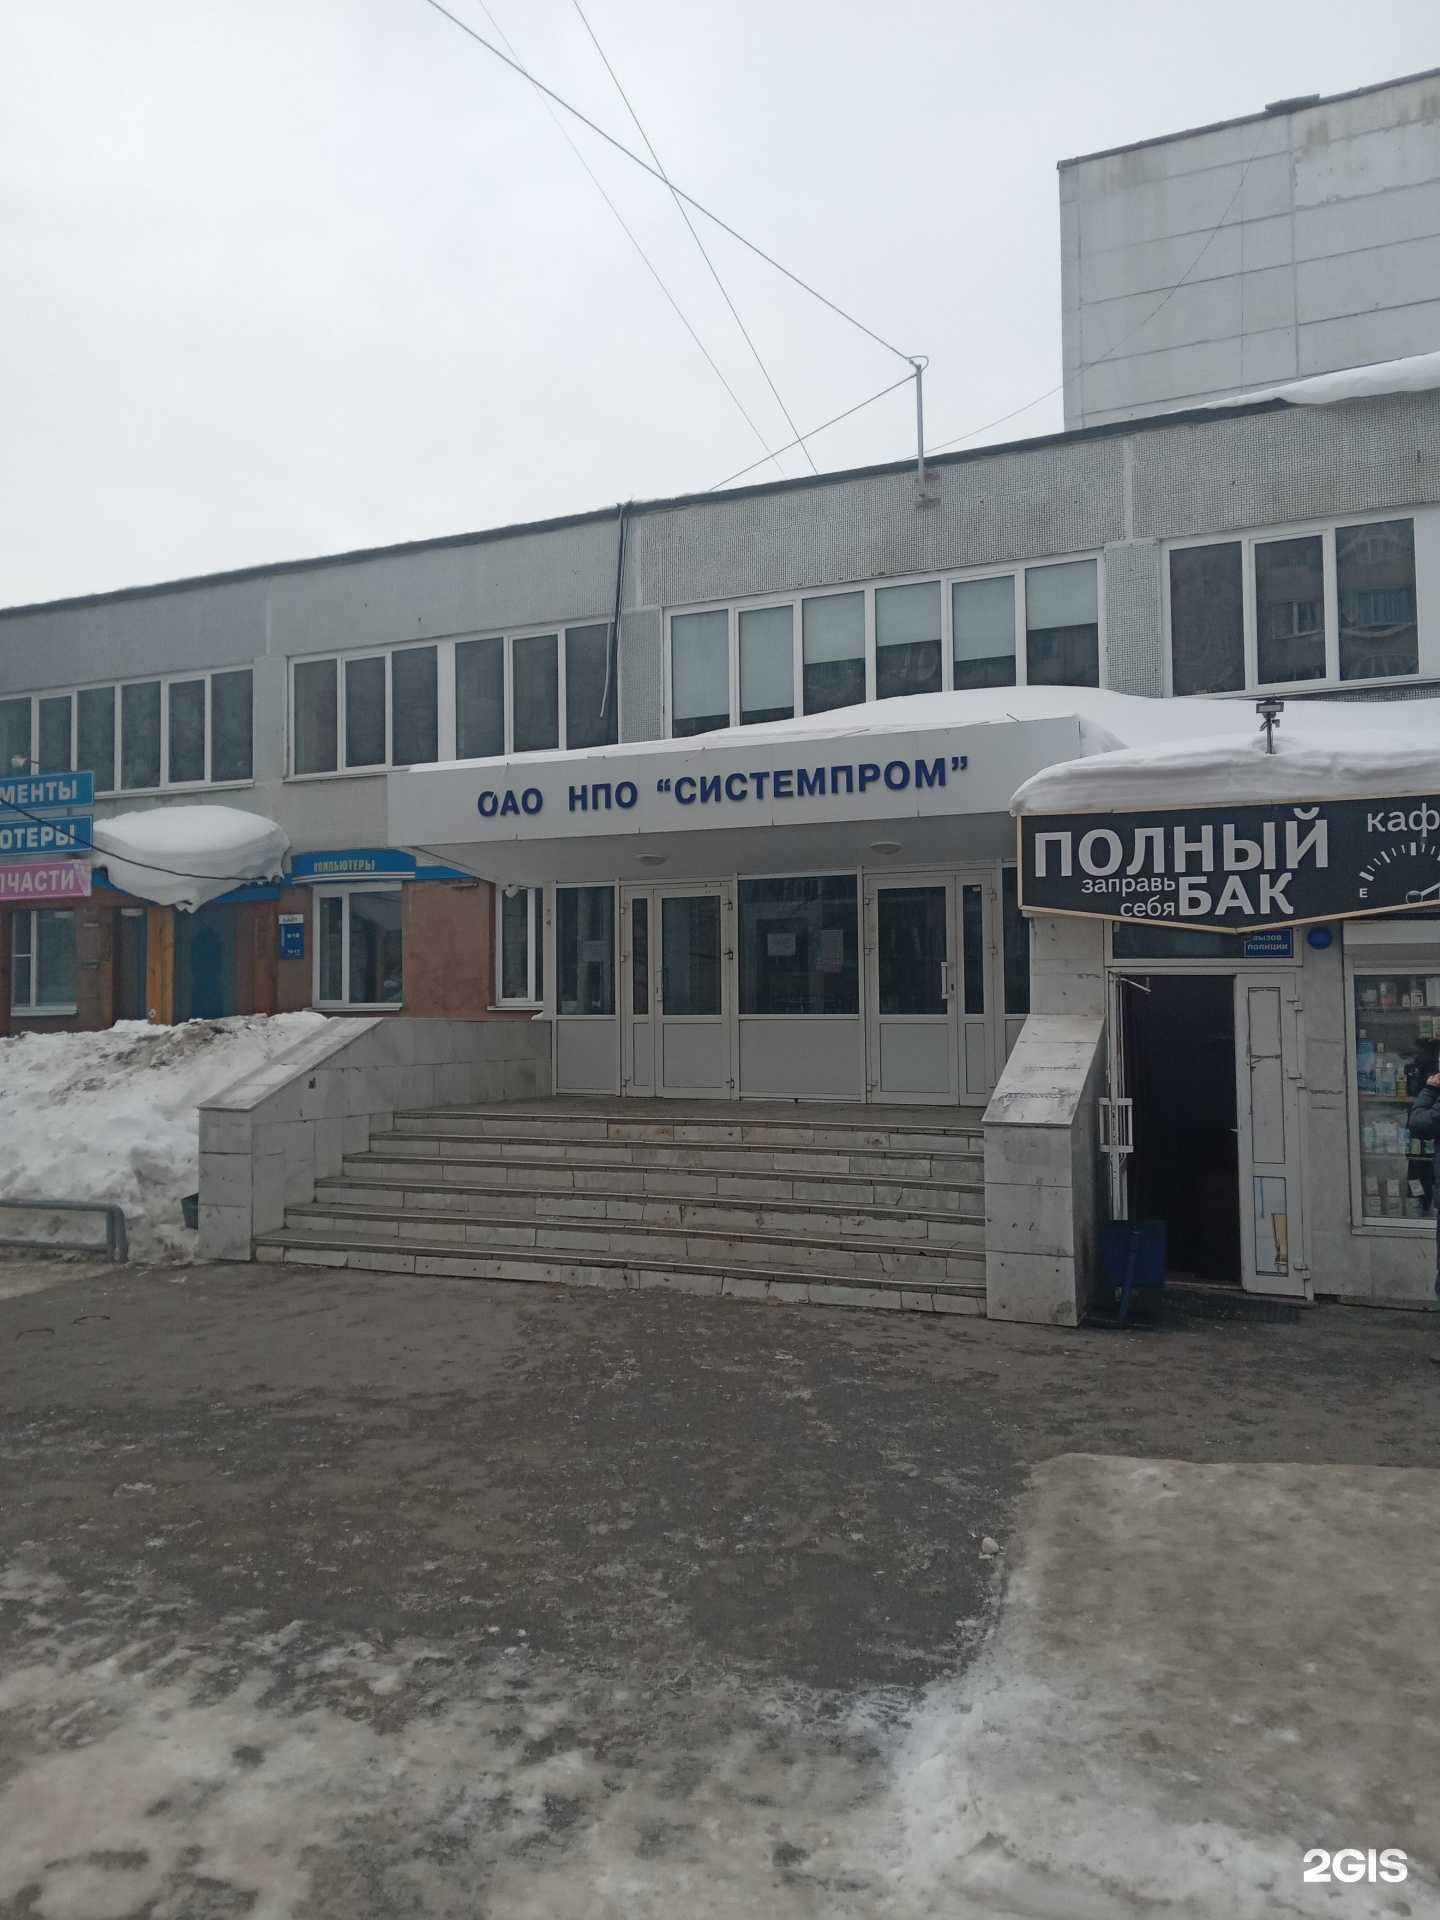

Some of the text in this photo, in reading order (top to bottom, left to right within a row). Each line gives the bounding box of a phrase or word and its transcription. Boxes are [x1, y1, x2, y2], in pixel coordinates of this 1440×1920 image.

[477, 756, 968, 817] ОАО НПО “СИСТЕМПРОМ”
[1034, 806, 1329, 878] ПОЛНЫЙ
[1081, 876, 1176, 896] заправь
[1120, 895, 1175, 917] себя
[1178, 872, 1294, 916] БАК
